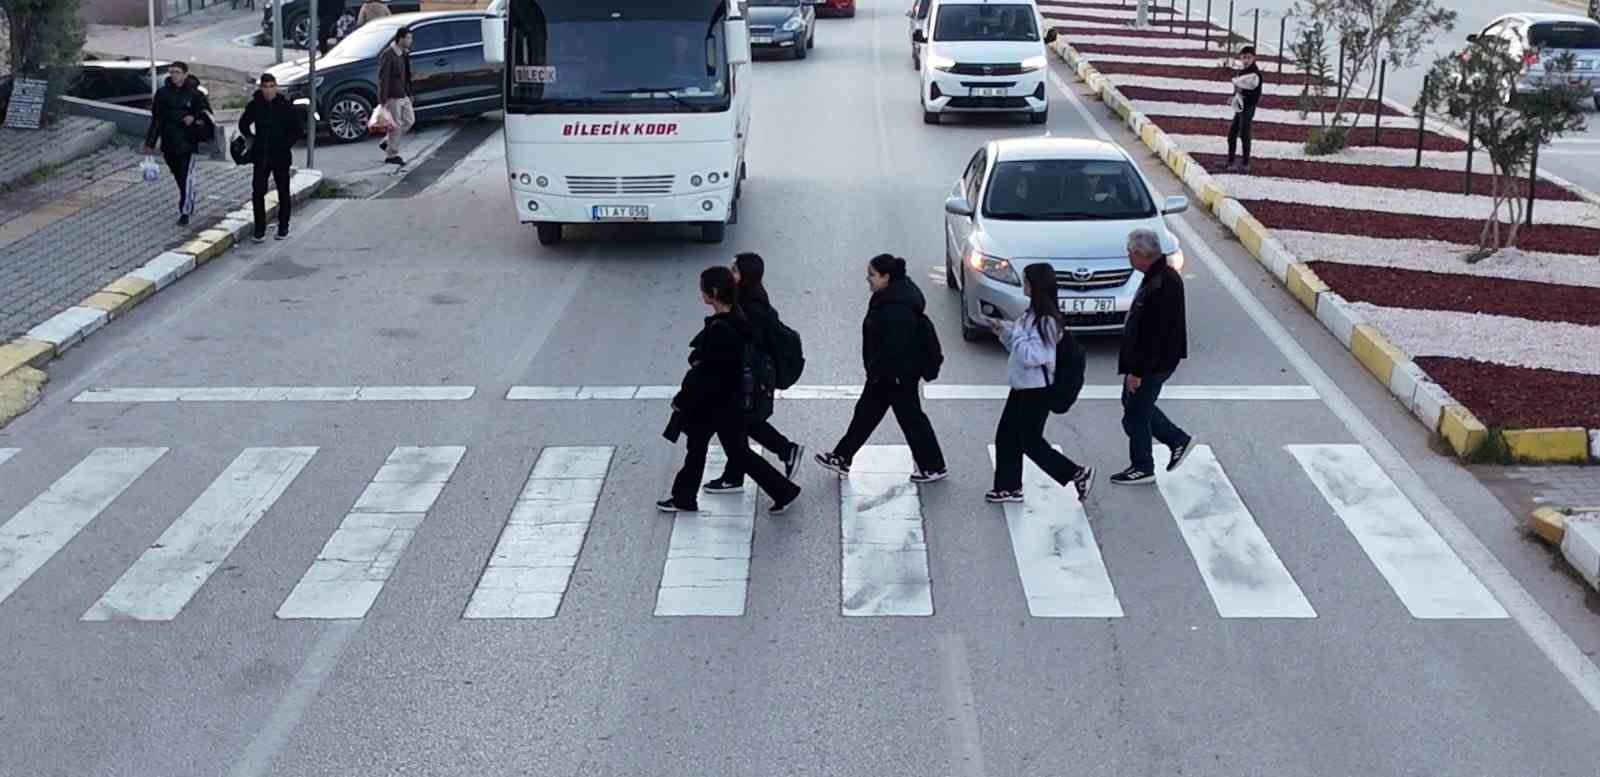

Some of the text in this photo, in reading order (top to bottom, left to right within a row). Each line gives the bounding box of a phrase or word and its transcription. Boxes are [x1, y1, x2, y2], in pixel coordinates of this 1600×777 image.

[563, 121, 631, 136] BİLECİK
[612, 206, 626, 217] AY
[1094, 300, 1113, 310] 787
